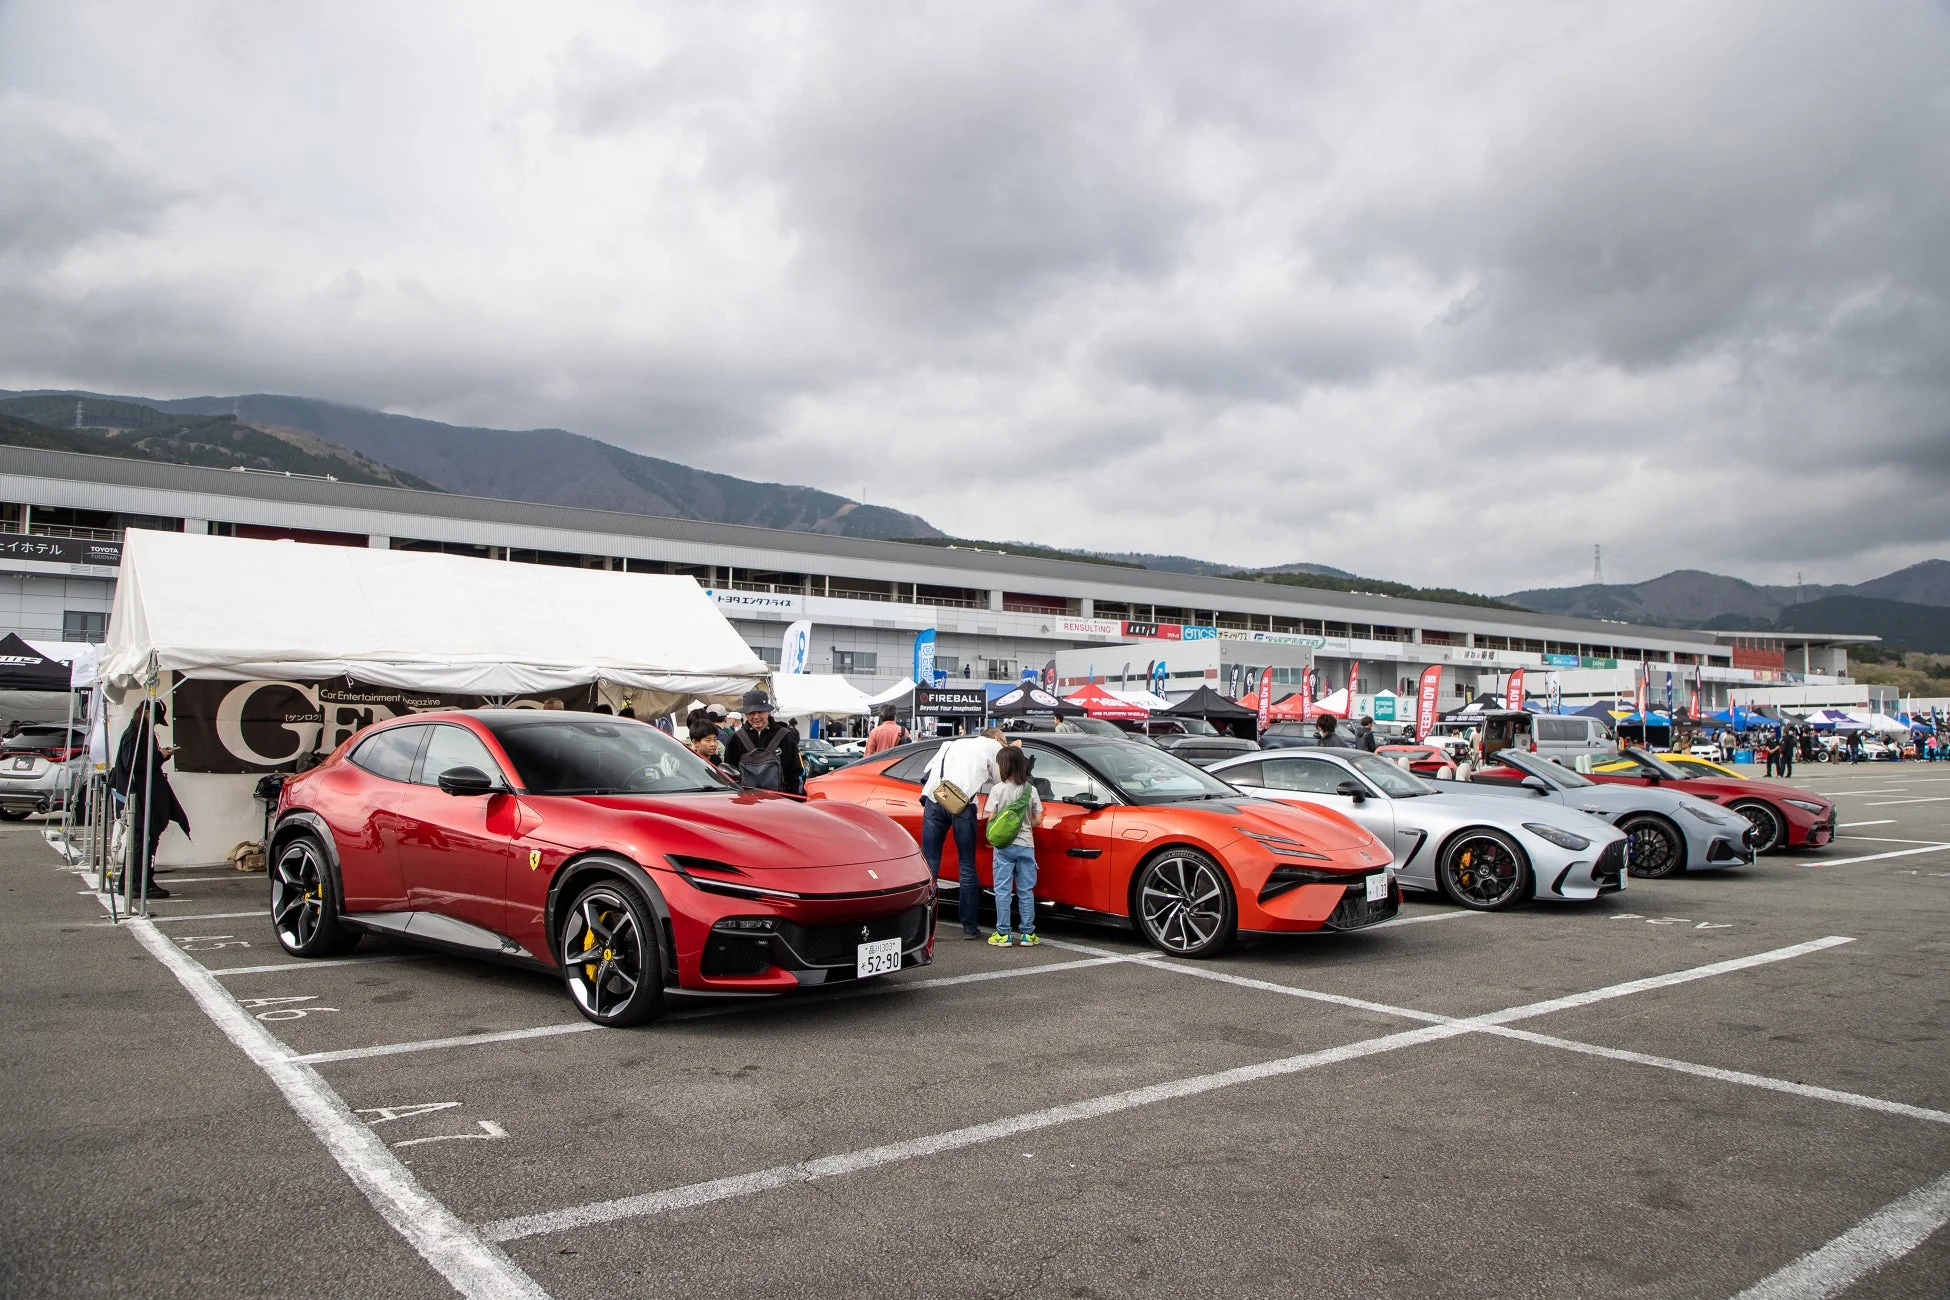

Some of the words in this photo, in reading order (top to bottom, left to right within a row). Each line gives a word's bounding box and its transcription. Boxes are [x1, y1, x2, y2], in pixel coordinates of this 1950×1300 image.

[90, 546, 119, 554] TOYOTA
[1063, 622, 1111, 634] RENSULTING
[320, 689, 336, 699] Car
[337, 690, 401, 702] Entertainment
[928, 694, 981, 703] FIREBALL
[1420, 700, 1434, 738] WHEELS
[868, 952, 899, 973] 52-90
